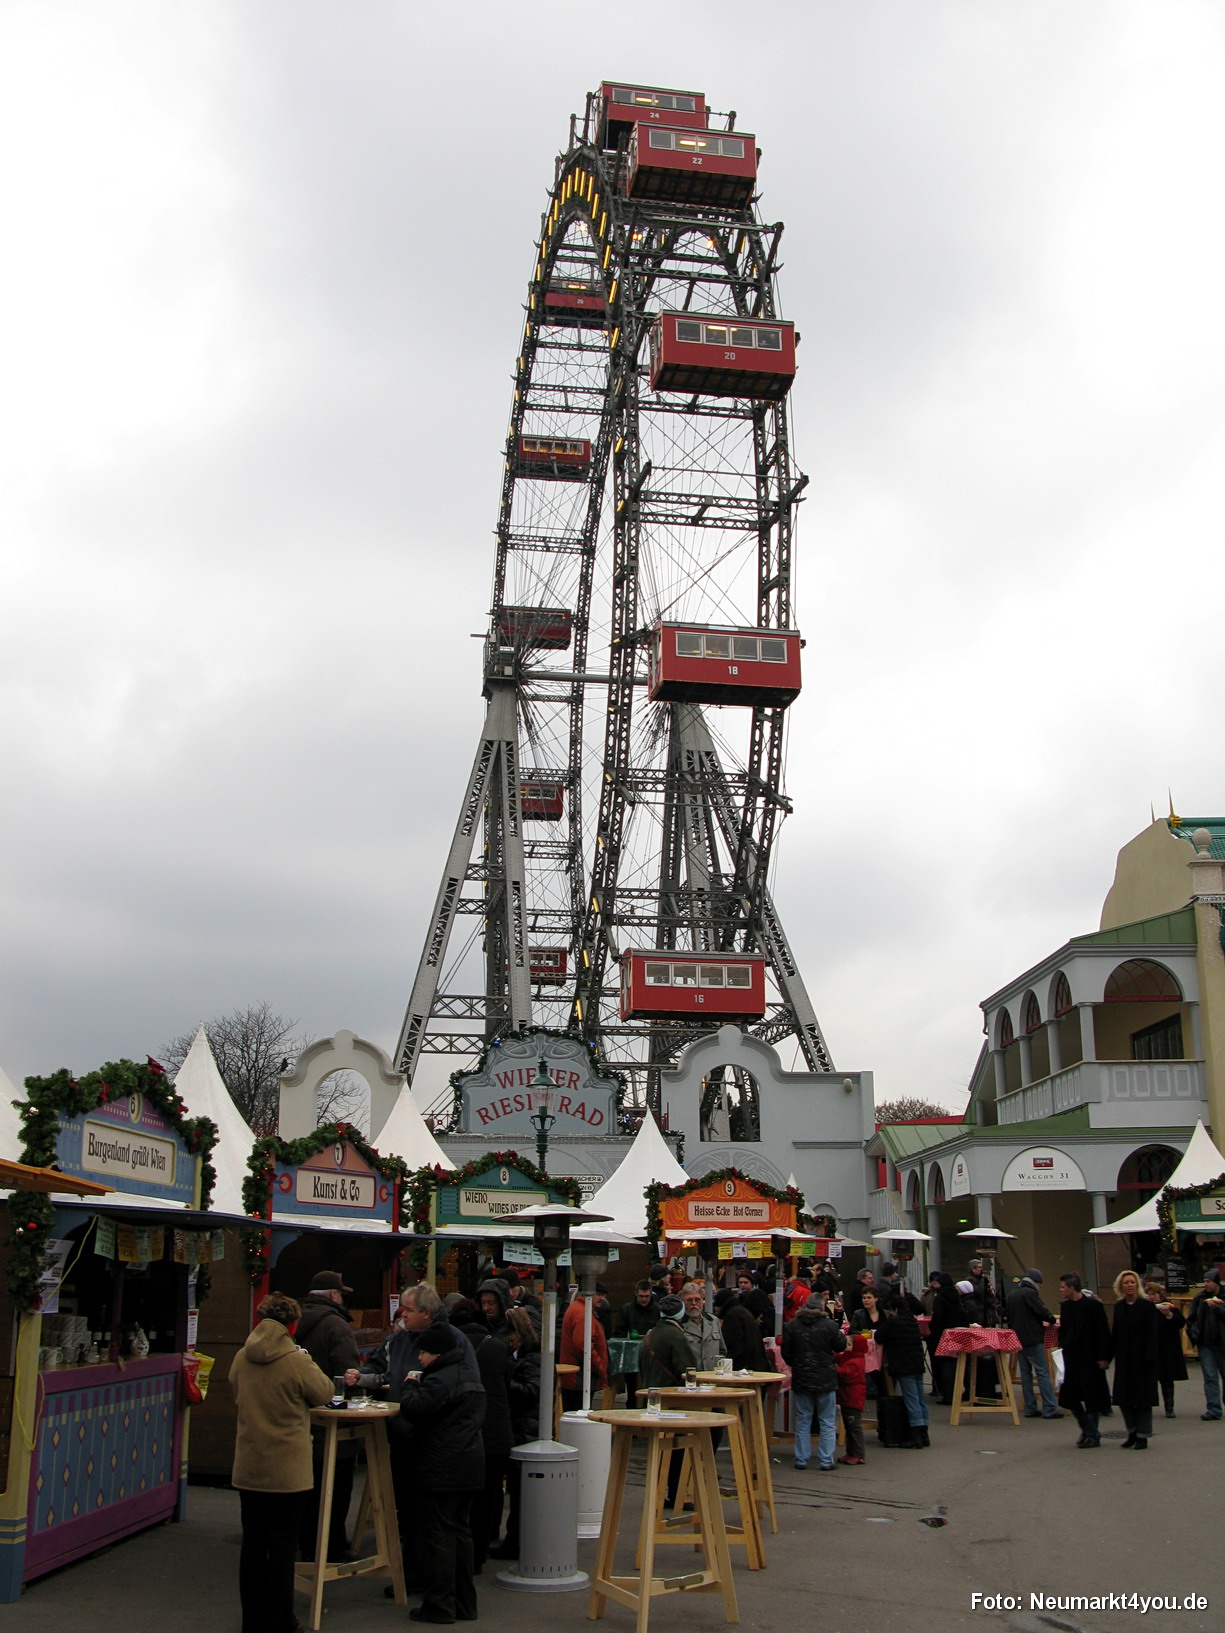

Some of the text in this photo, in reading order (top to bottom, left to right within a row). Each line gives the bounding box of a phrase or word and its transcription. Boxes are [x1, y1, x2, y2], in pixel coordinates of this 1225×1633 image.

[692, 157, 703, 165] 22
[724, 351, 736, 360] 20
[727, 665, 738, 675] 18
[694, 994, 704, 1003] 16
[495, 1067, 581, 1091] WIEER
[130, 1096, 136, 1114] 6
[87, 1132, 166, 1171] Burgenland grüßt Wien
[335, 1147, 340, 1160] 7
[501, 1170, 507, 1182] 8
[312, 1175, 360, 1201] Kunst & Co
[727, 1183, 732, 1193] 9
[488, 1202, 509, 1214] WINES
[510, 1202, 519, 1213] OF
[694, 1205, 763, 1217] Heisse Ecke Hot Corner
